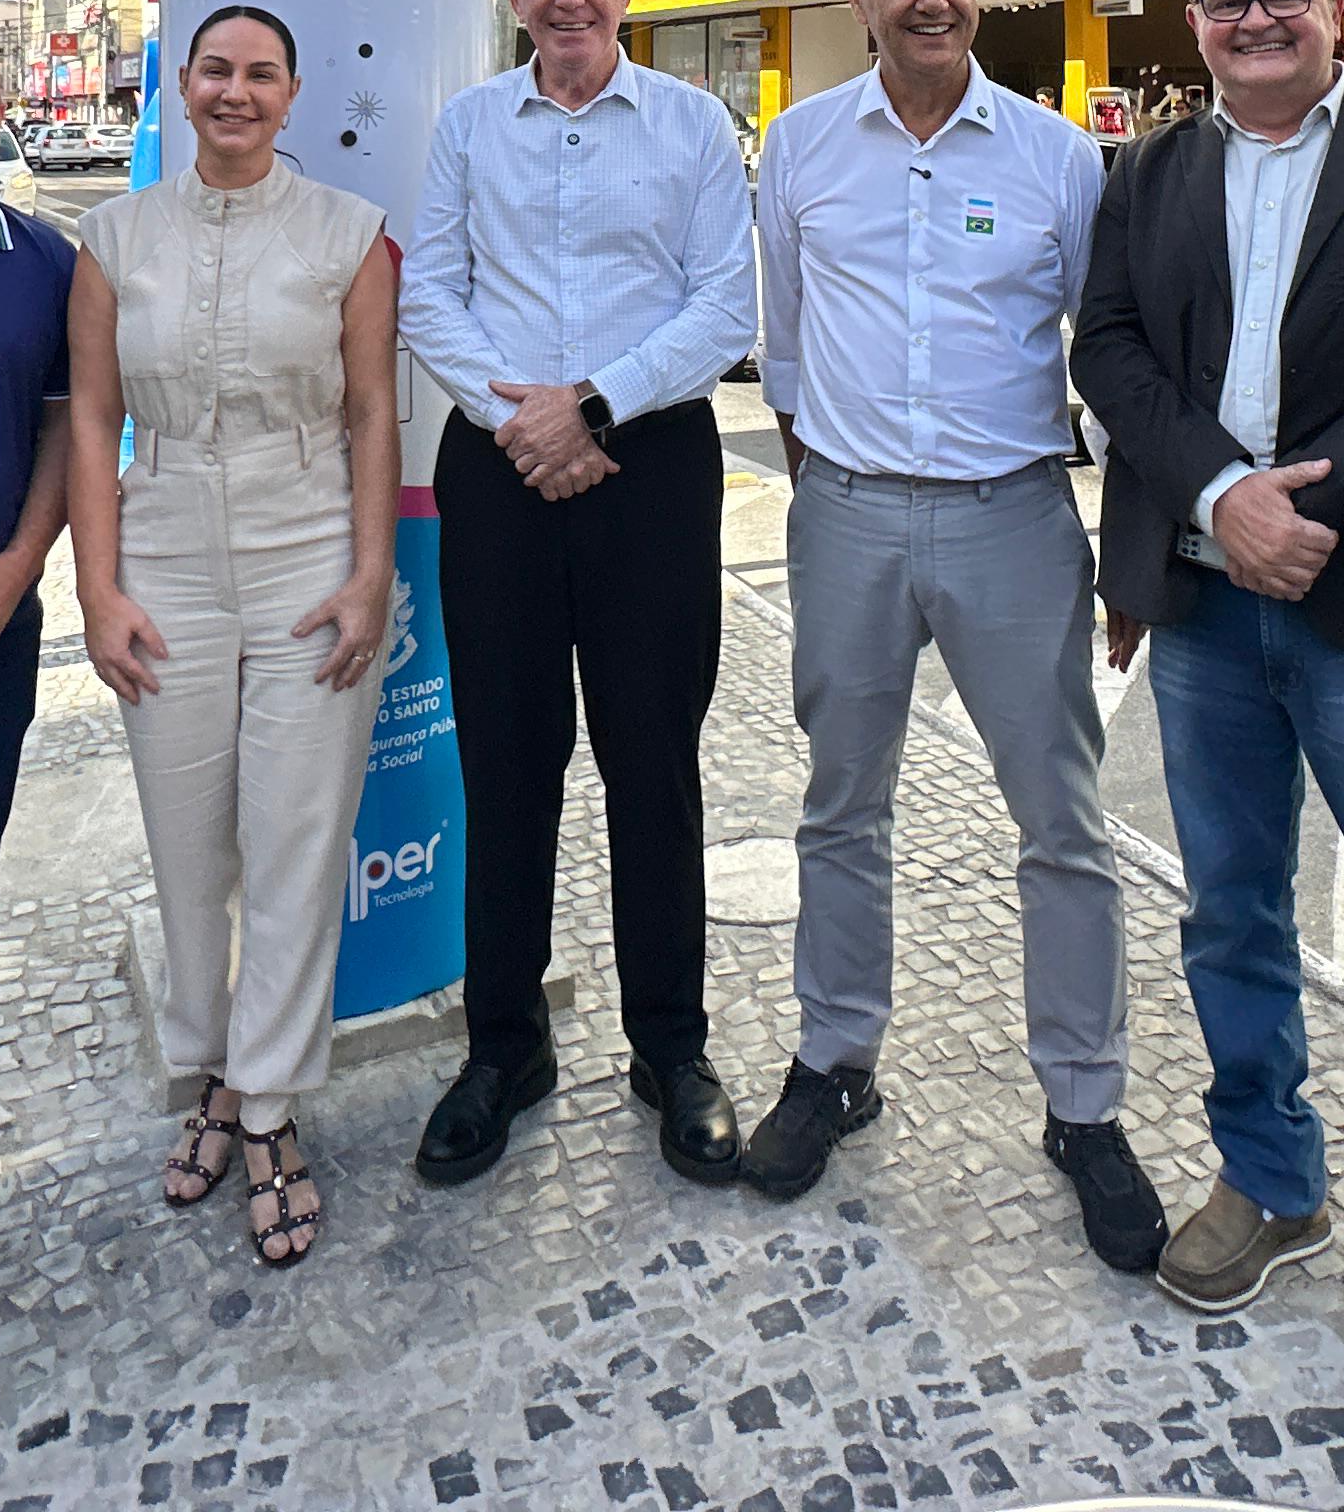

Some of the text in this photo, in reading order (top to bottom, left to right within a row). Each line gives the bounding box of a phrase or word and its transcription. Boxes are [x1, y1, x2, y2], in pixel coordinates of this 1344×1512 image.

[391, 676, 445, 703] ESTADO
[394, 696, 441, 721] SANTO
[369, 728, 427, 756] gurança
[380, 745, 424, 770] Social
[373, 880, 434, 908] Tecnologia
